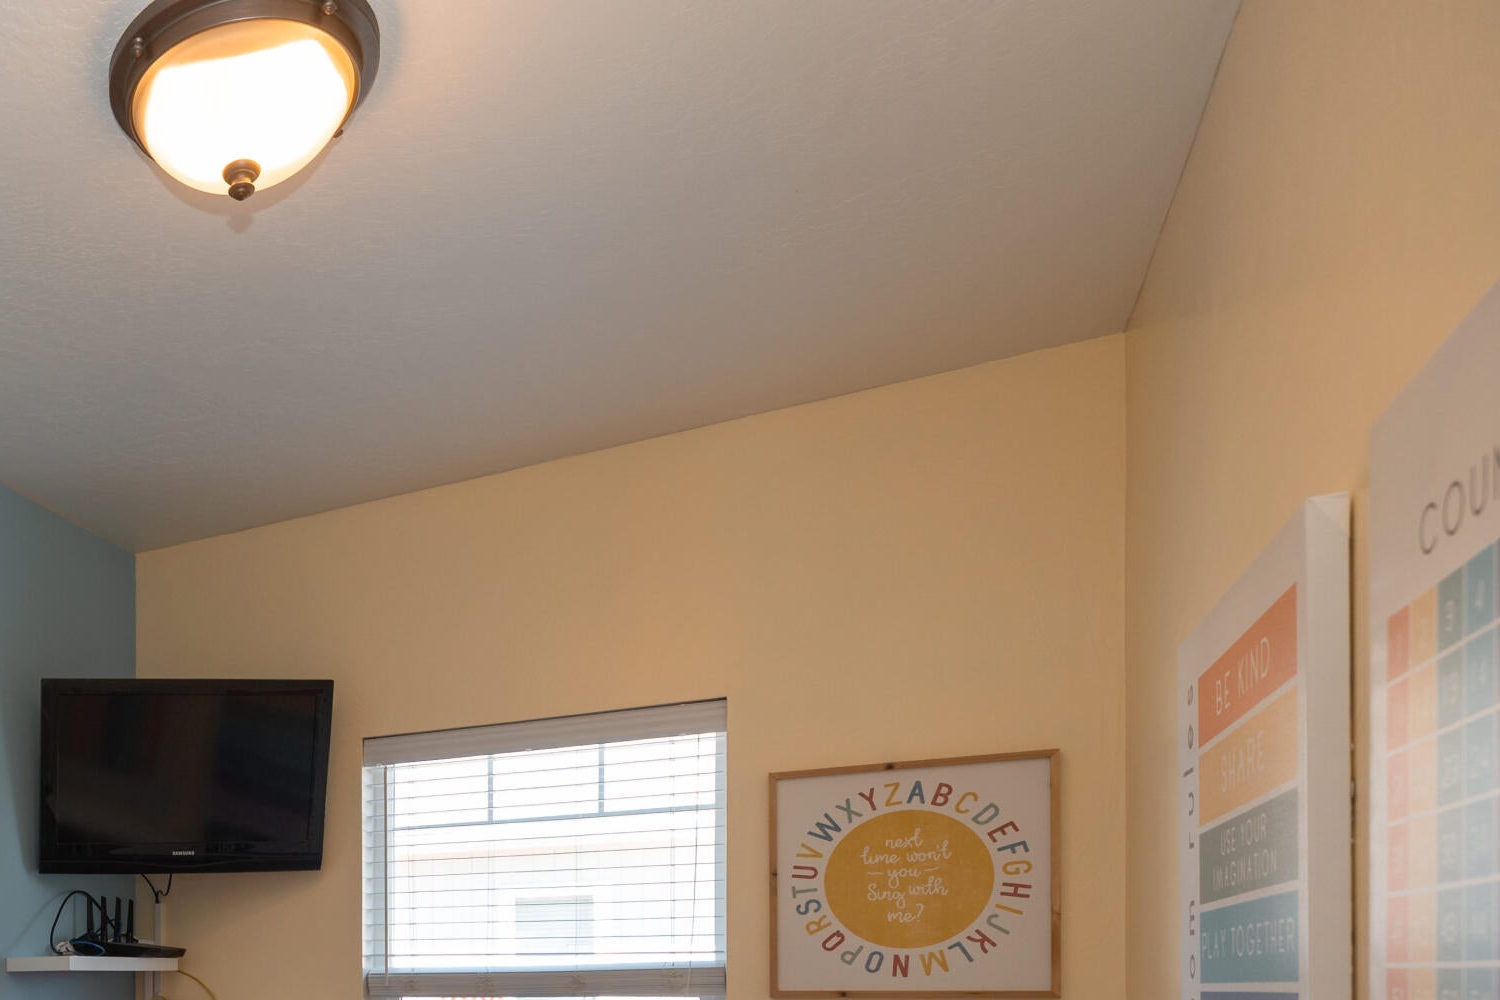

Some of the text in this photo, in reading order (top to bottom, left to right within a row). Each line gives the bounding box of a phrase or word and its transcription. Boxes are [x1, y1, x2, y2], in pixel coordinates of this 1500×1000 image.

[1216, 636, 1271, 716] BE KIND
[1220, 730, 1266, 794] SHARE
[885, 828, 923, 849] next
[1220, 812, 1267, 857] USE YOUR
[860, 840, 952, 865] time won't
[887, 867, 921, 888] you
[909, 876, 949, 897] with
[1212, 850, 1278, 891] IMAGINATION
[887, 903, 924, 923] me?
[1201, 915, 1296, 961] PLAY TOGETHER
